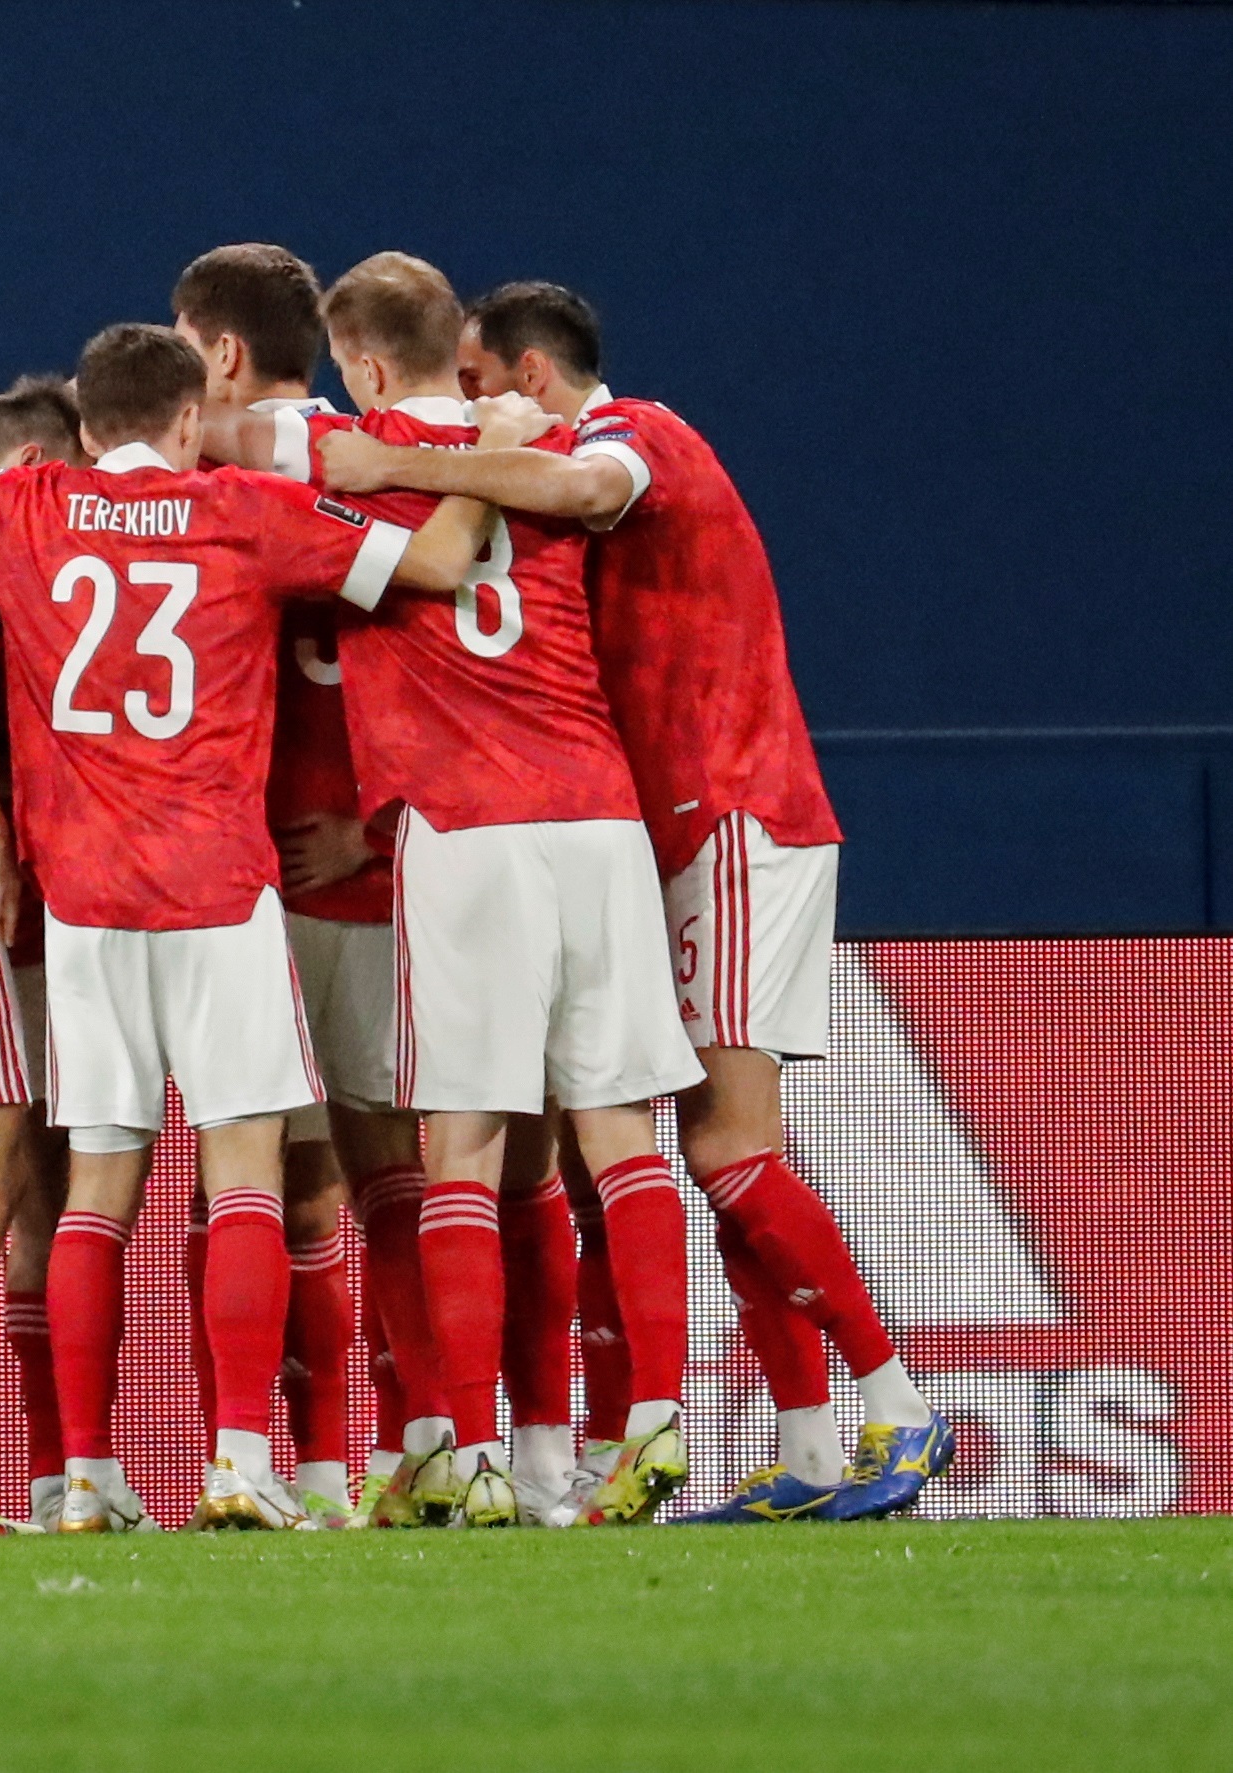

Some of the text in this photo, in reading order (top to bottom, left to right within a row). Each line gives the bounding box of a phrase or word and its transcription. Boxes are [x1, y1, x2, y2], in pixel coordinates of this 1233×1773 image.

[67, 493, 192, 536] TEREKHOV
[455, 508, 524, 659] 8
[51, 555, 198, 740] 23
[677, 914, 700, 985] 5
